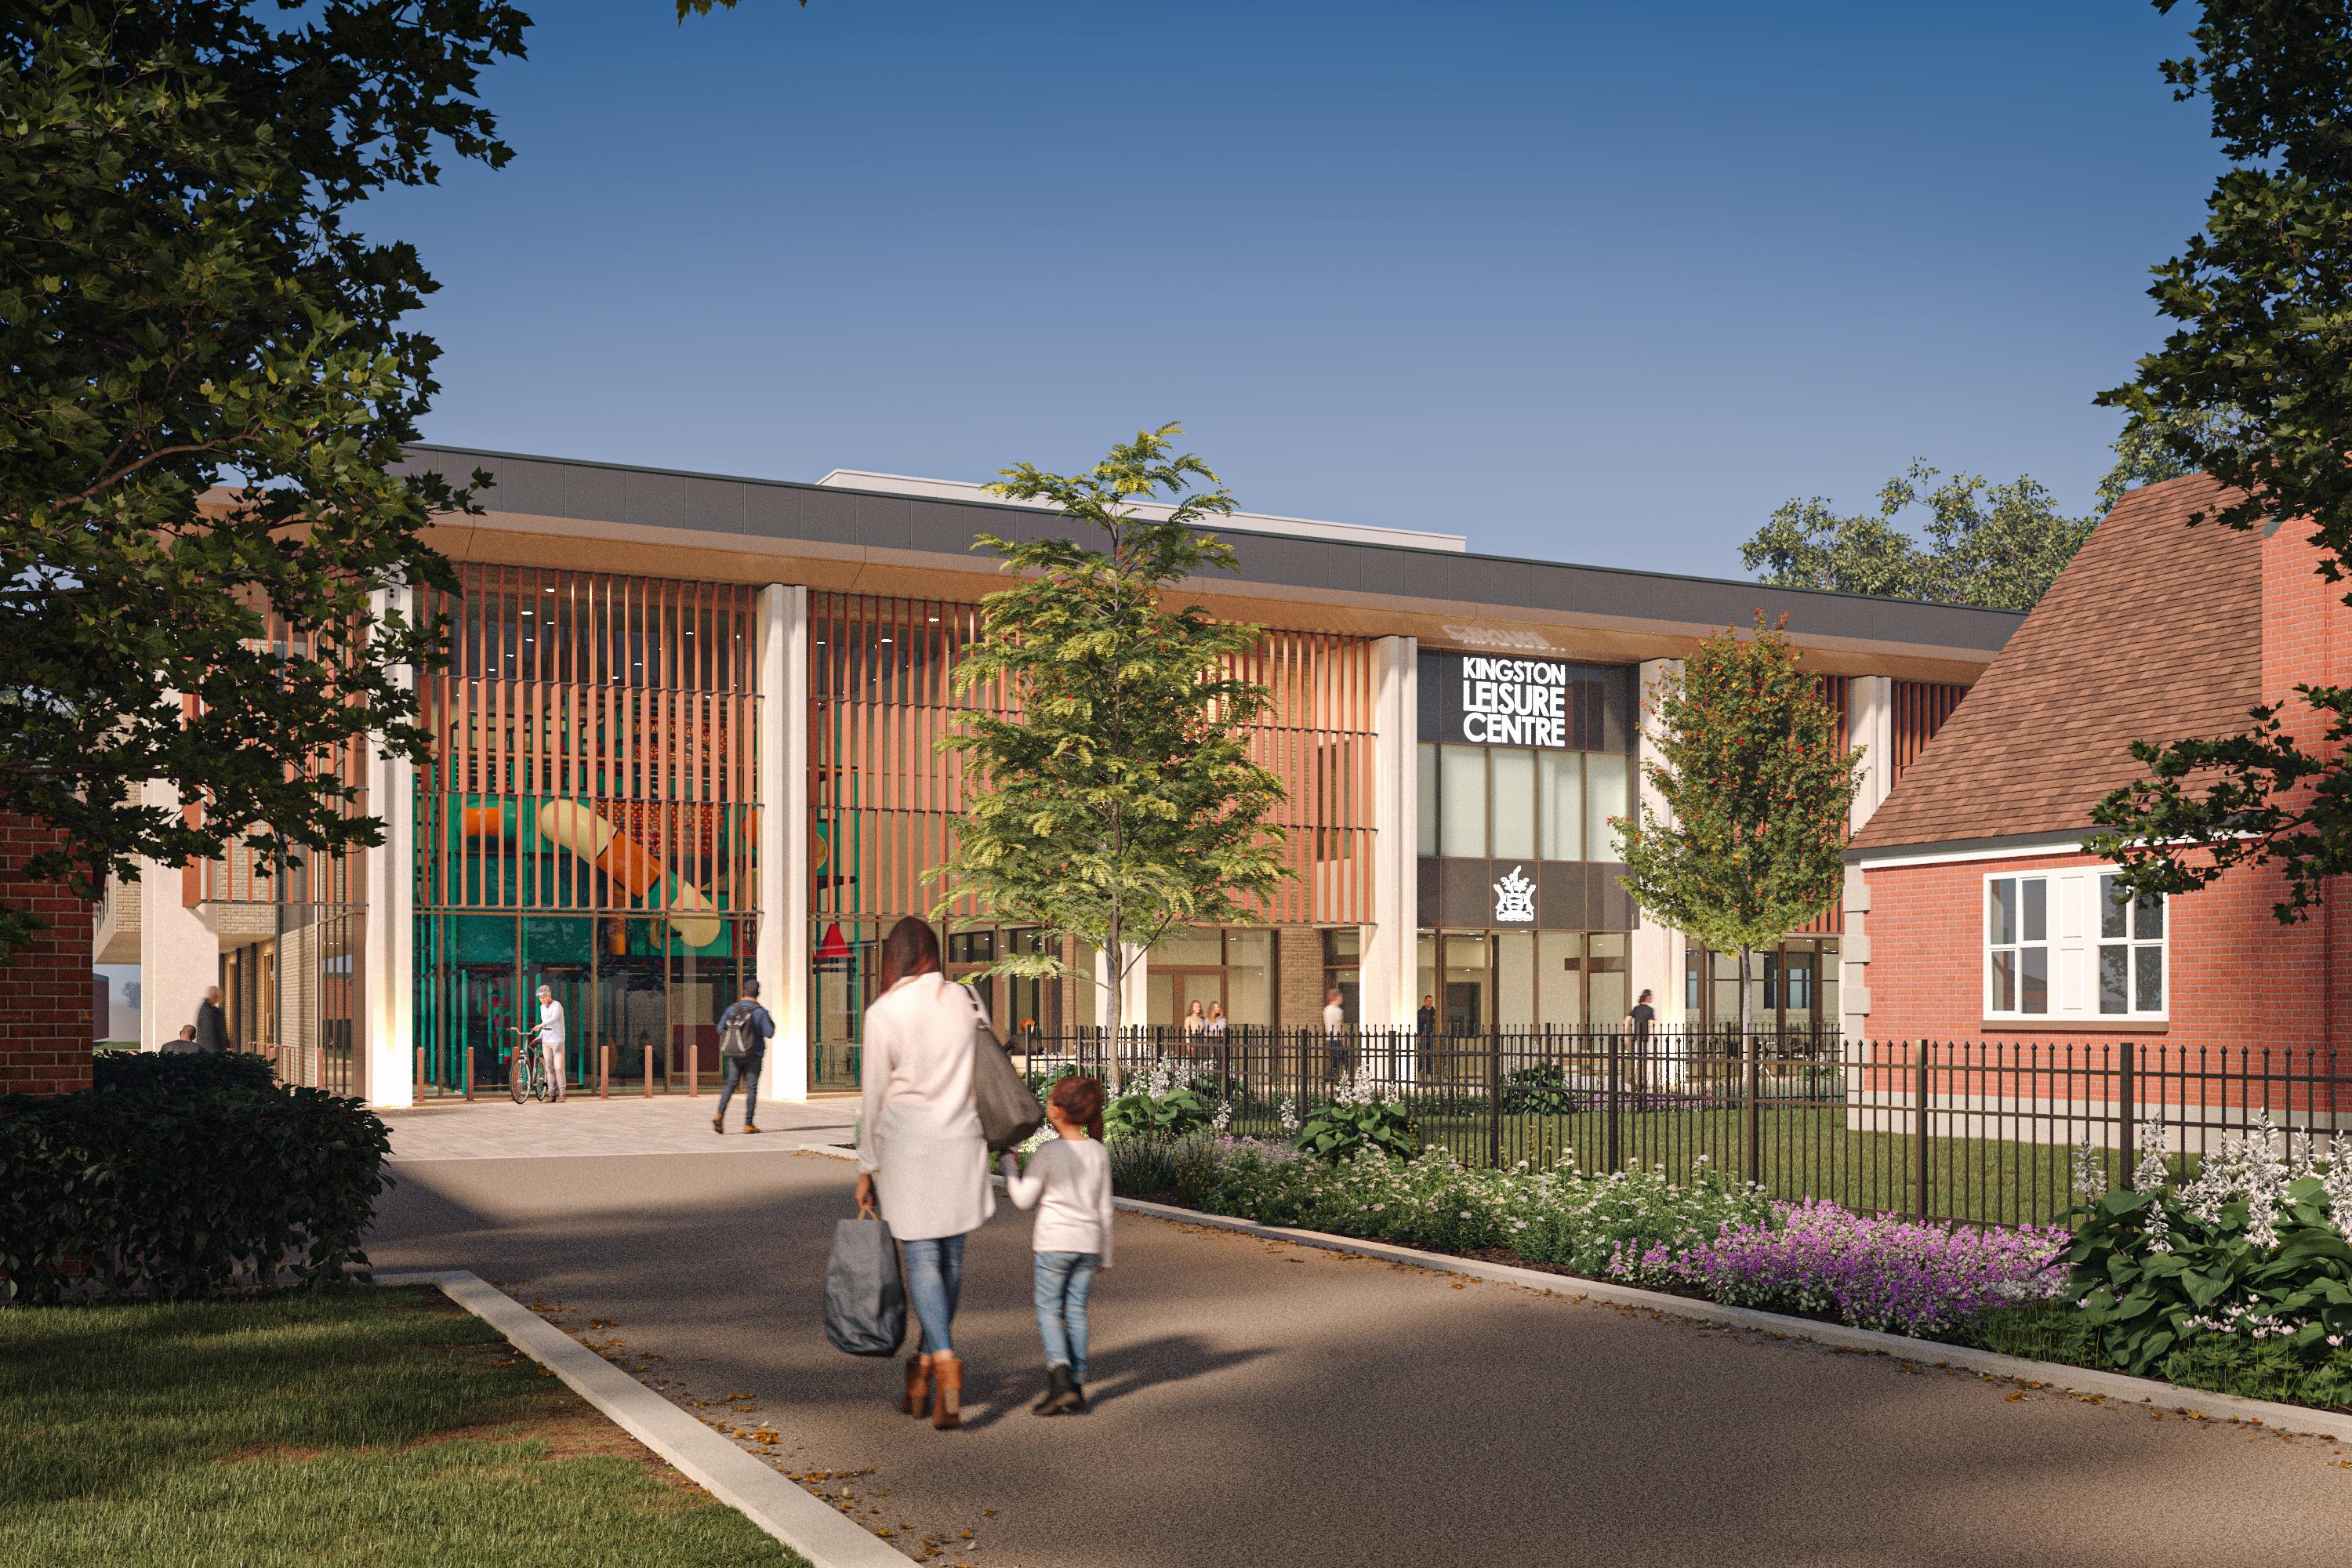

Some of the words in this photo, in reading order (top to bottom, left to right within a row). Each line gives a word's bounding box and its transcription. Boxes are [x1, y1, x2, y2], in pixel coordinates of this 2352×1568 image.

[1463, 657, 1565, 685] KINGSTON
[1463, 681, 1565, 717] LEISURE
[1463, 713, 1565, 746] CENTRE
